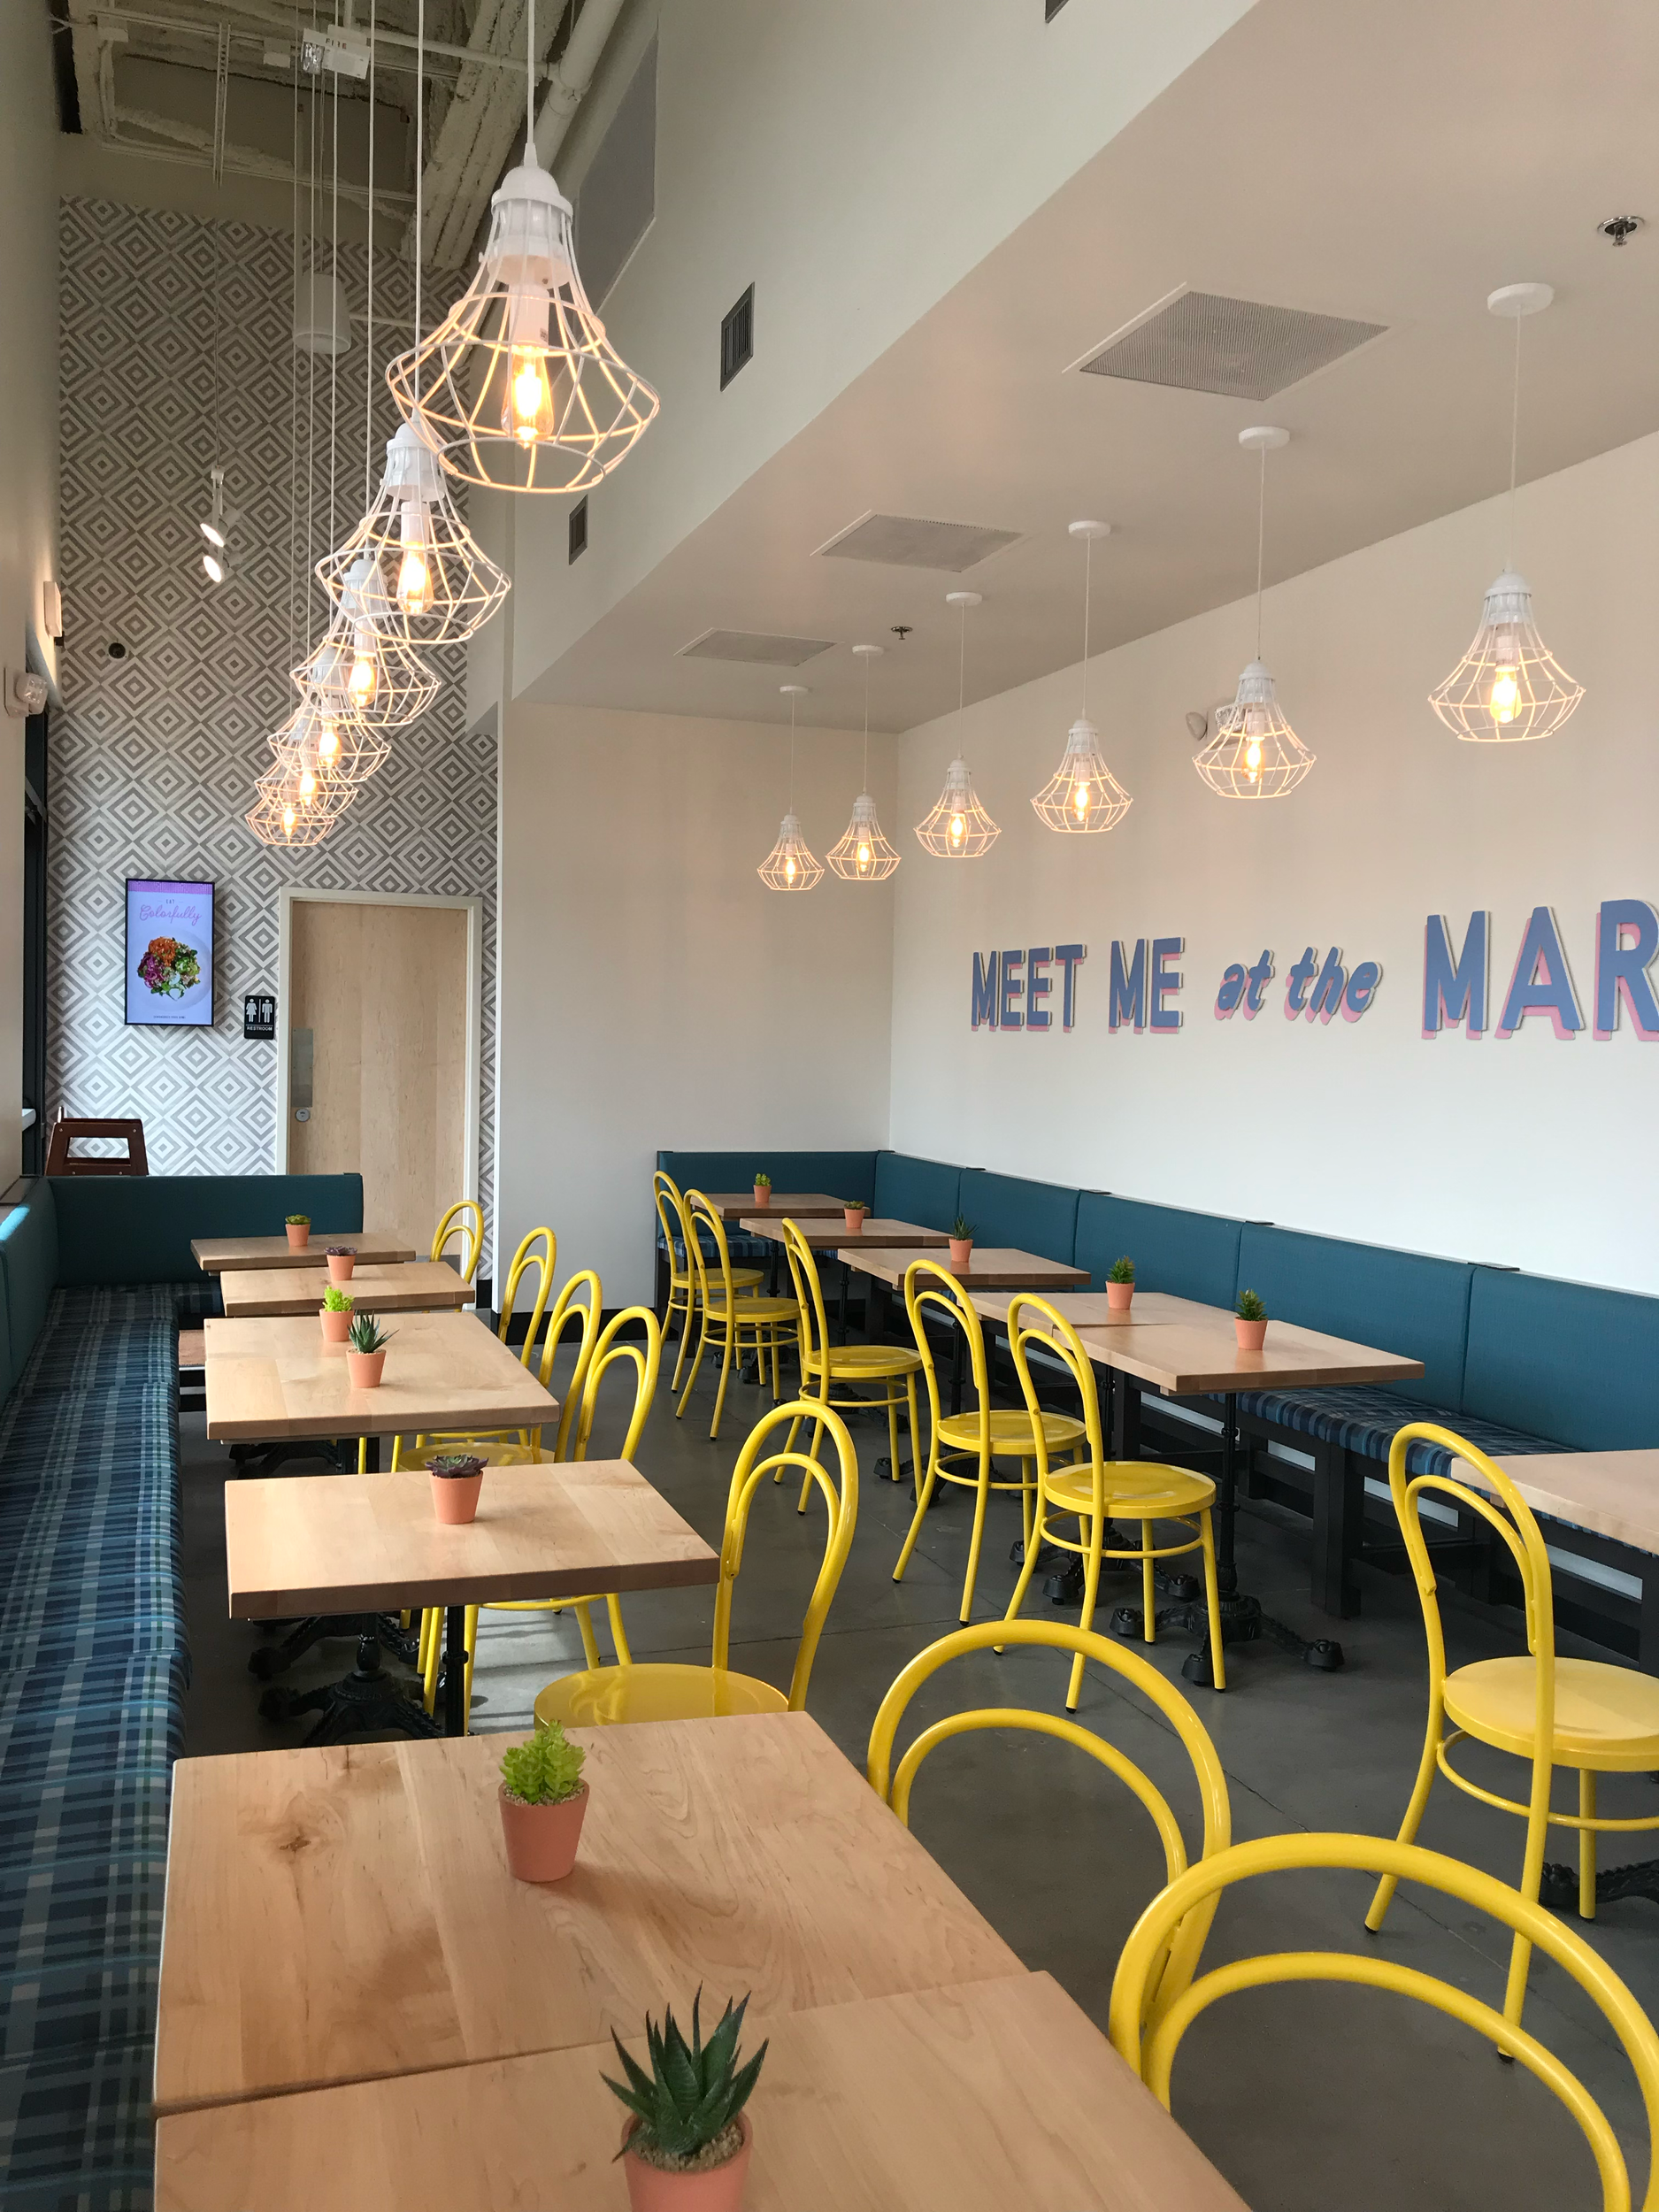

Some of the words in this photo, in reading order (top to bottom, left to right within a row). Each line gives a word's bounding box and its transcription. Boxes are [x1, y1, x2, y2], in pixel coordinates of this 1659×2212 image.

[139, 904, 203, 926] Colorfully
[972, 944, 1087, 1033] MEET
[1109, 937, 1185, 1034] ME
[1214, 949, 1275, 1021] at
[1284, 947, 1383, 1025] the
[1421, 899, 1659, 1041] MAR
